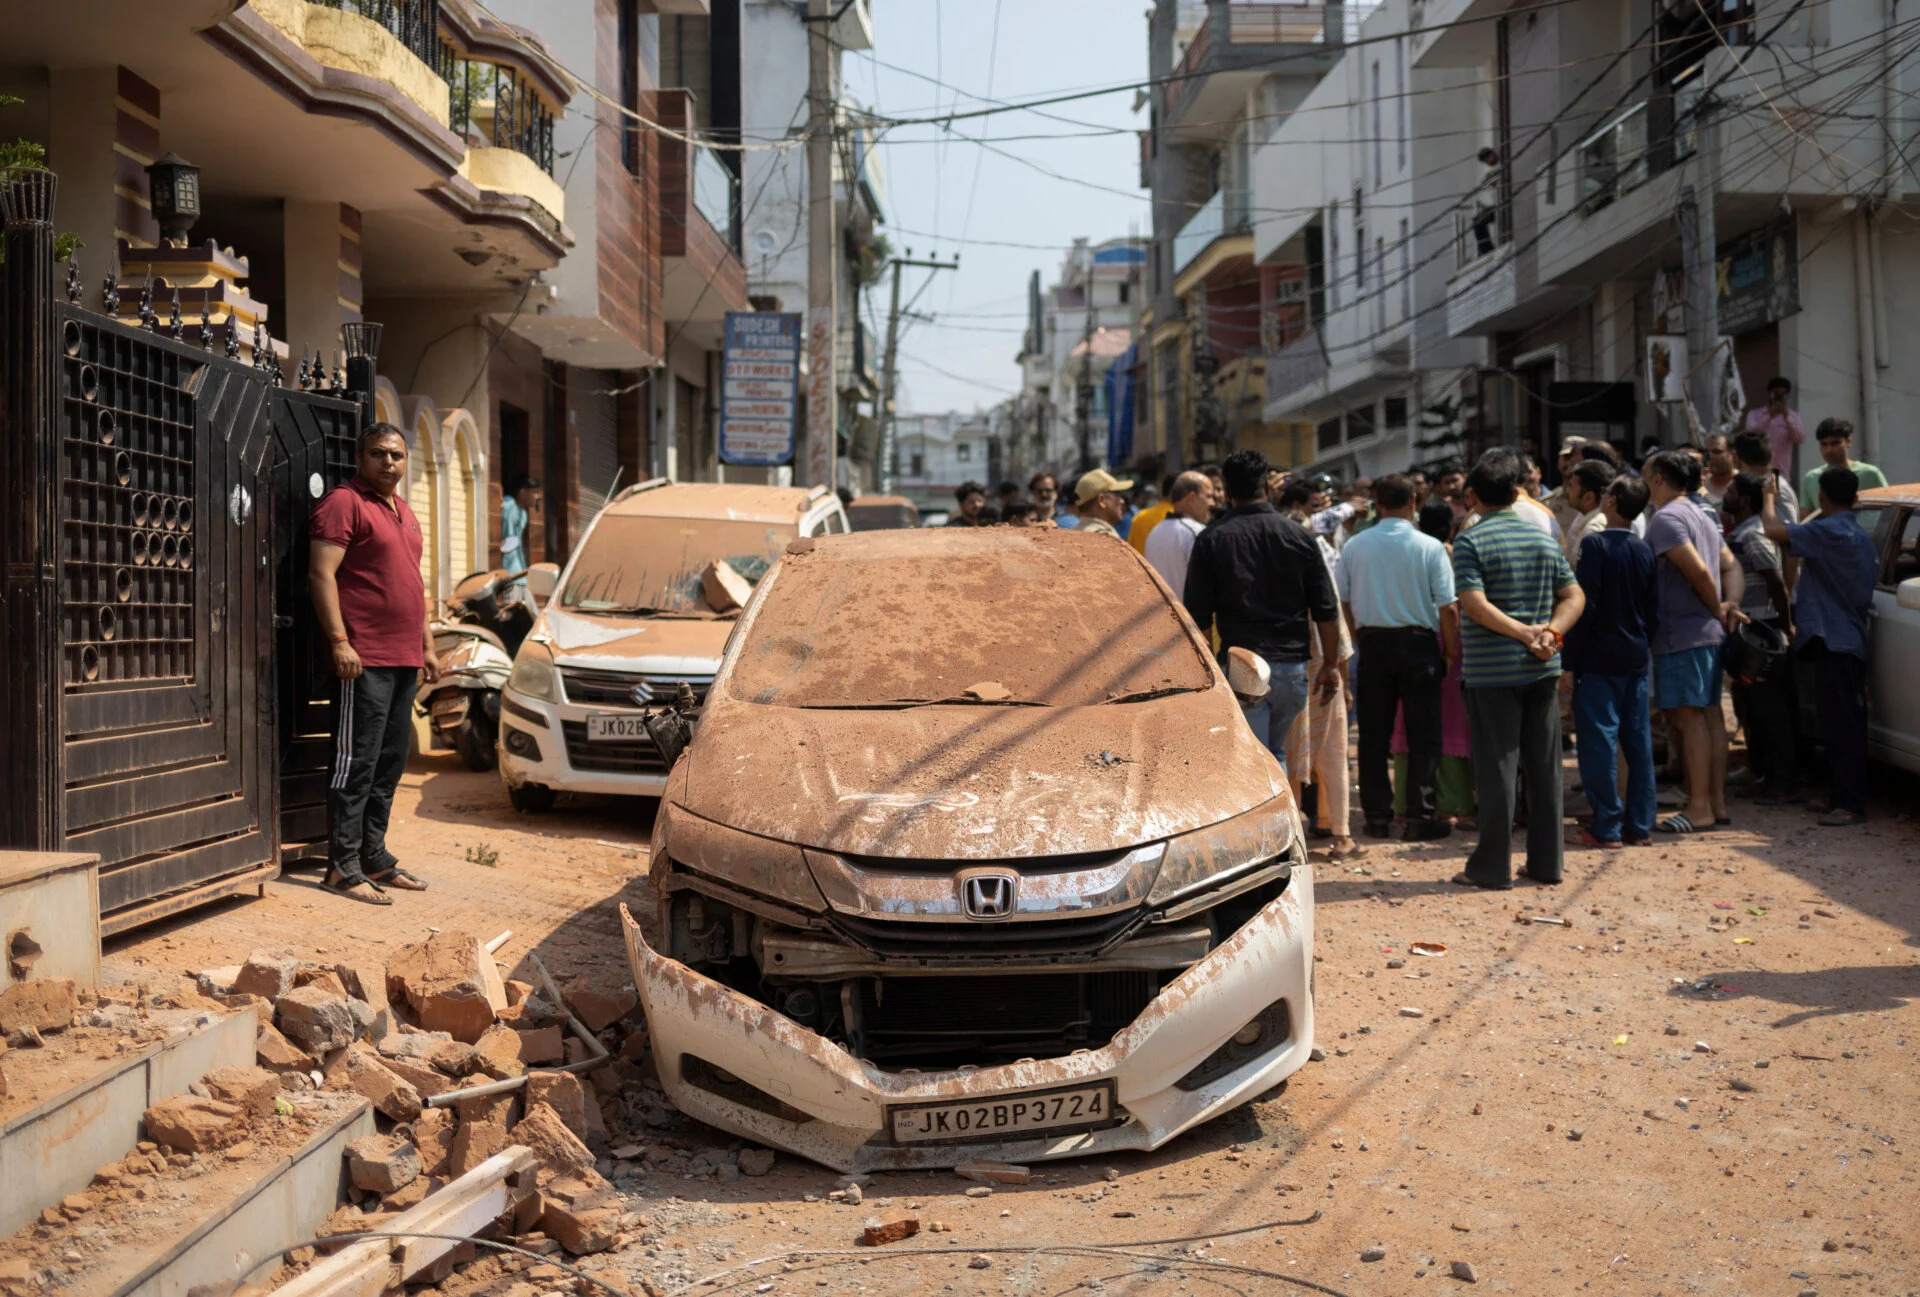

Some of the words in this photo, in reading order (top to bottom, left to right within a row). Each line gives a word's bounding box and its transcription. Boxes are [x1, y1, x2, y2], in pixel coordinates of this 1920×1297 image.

[734, 317, 780, 332] SUDESH
[745, 335, 793, 346] PRINTERS
[752, 364, 791, 377] WORKS
[897, 1119, 914, 1129] IND
[918, 1092, 1103, 1133] JK02BP3724
